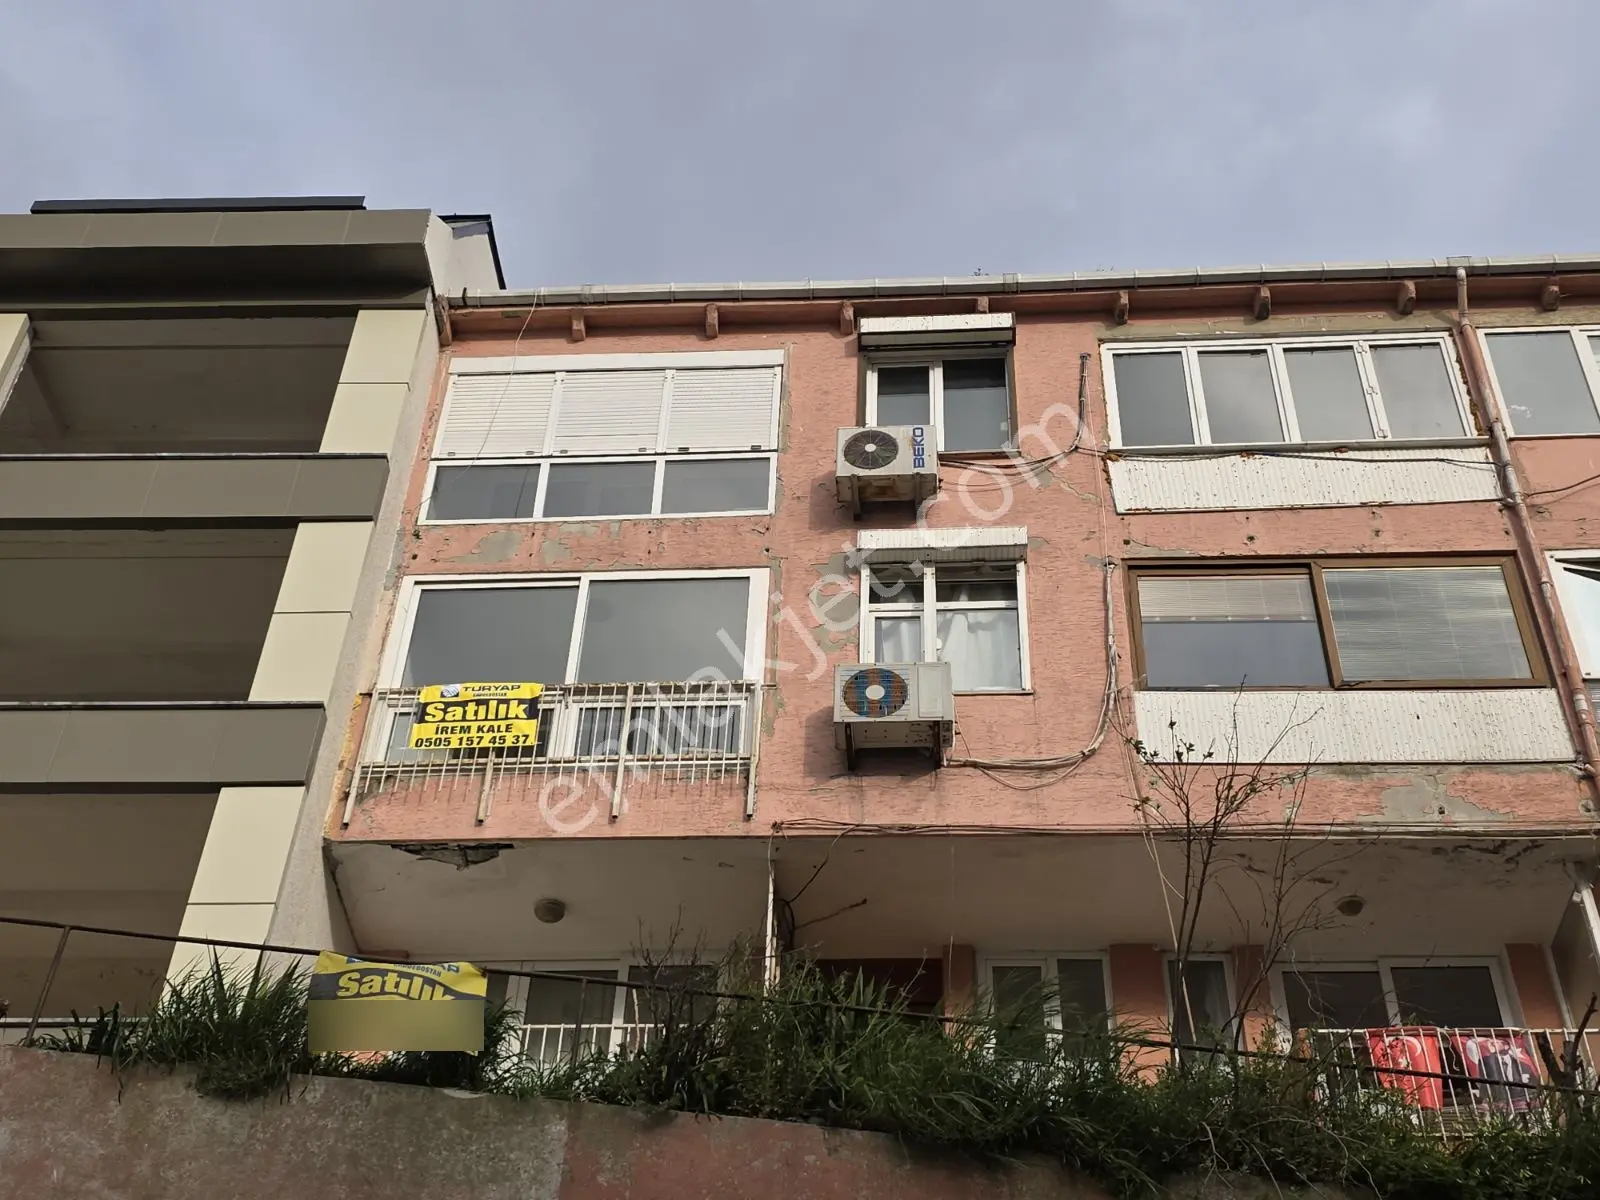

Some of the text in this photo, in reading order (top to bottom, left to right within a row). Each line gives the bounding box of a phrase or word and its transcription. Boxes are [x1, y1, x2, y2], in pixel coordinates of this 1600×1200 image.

[912, 427, 925, 468] BEKO
[463, 684, 521, 692] TURYAP
[425, 700, 528, 721] Satılık
[435, 723, 513, 735] İREM KALE
[415, 734, 530, 748] 0505 157 45 37
